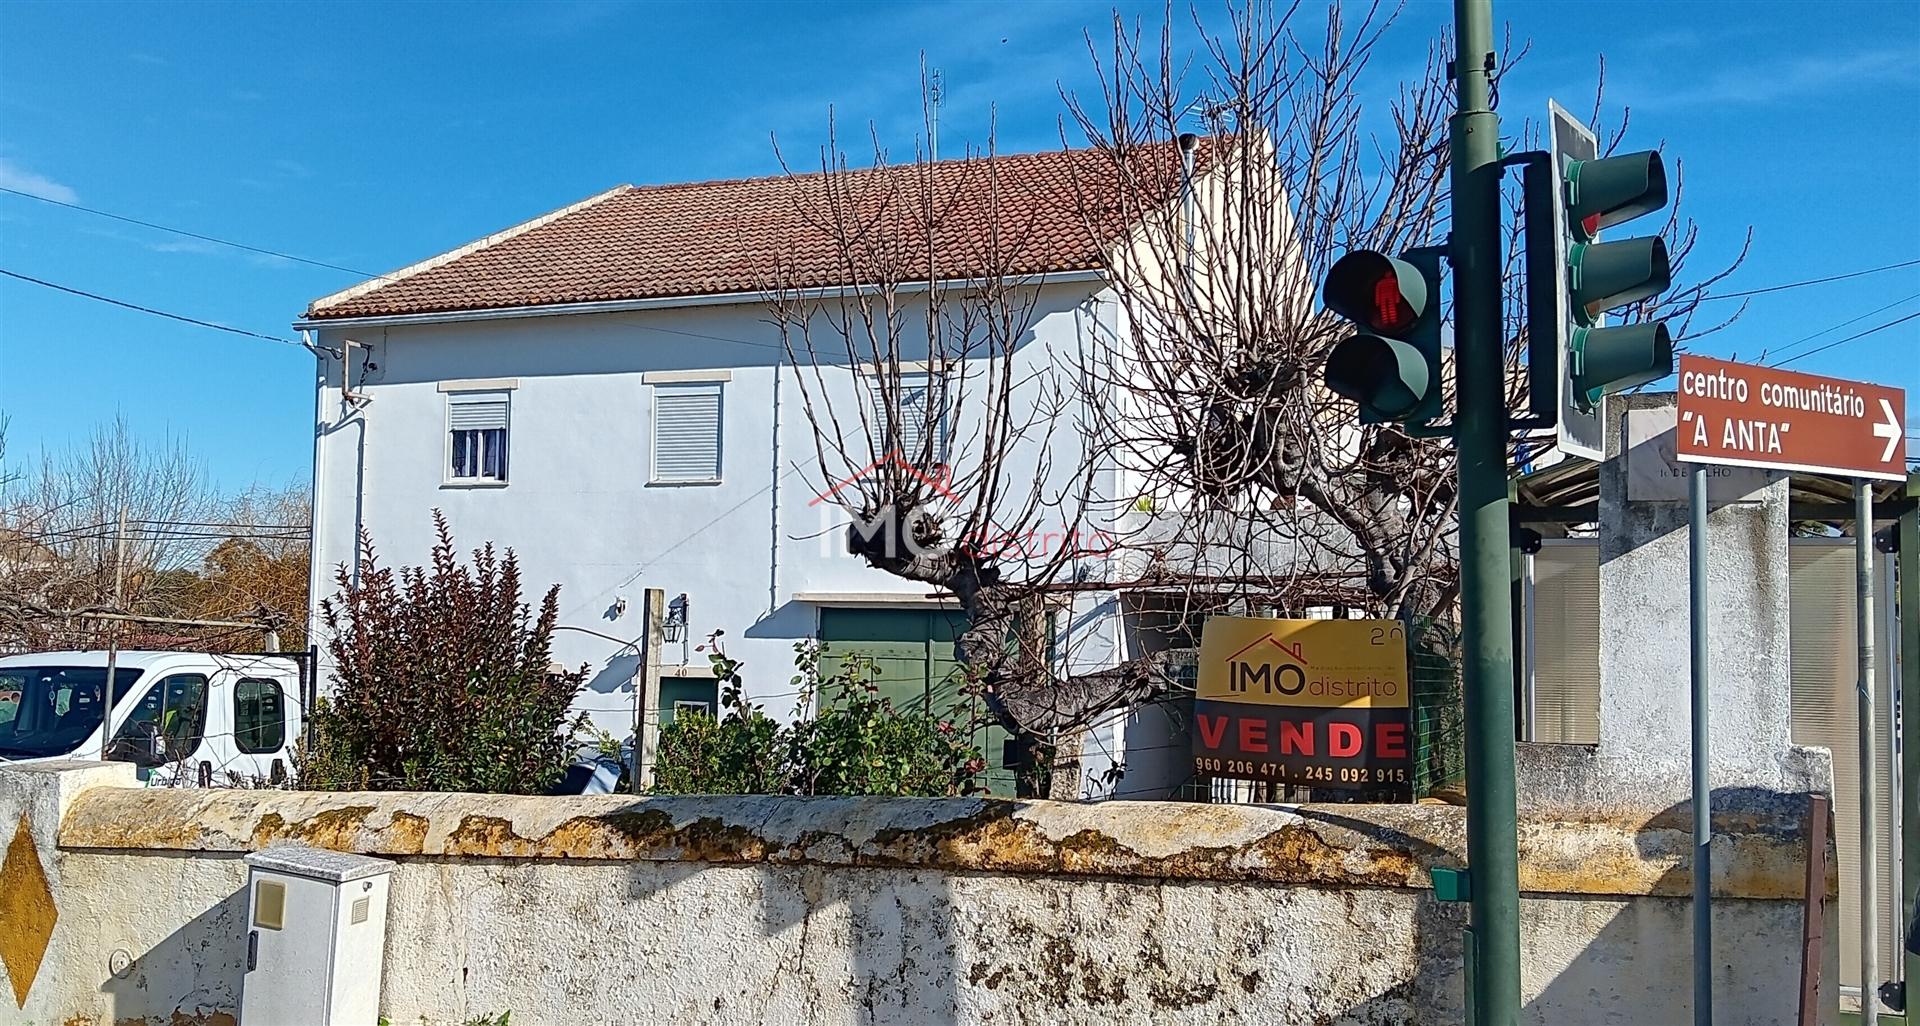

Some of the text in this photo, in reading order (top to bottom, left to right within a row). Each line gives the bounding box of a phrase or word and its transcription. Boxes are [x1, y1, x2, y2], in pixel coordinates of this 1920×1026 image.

[1683, 368, 1865, 418] centro comunitário
[673, 668, 688, 677] 40
[1231, 661, 1398, 697] IMO distrito
[1197, 715, 1406, 758] VENDE
[1196, 758, 1221, 773] 960
[1227, 760, 1254, 775] 206
[1260, 763, 1287, 777] 471
[1305, 766, 1333, 781] 245
[1340, 768, 1369, 783] 092
[1376, 768, 1404, 783] 915
